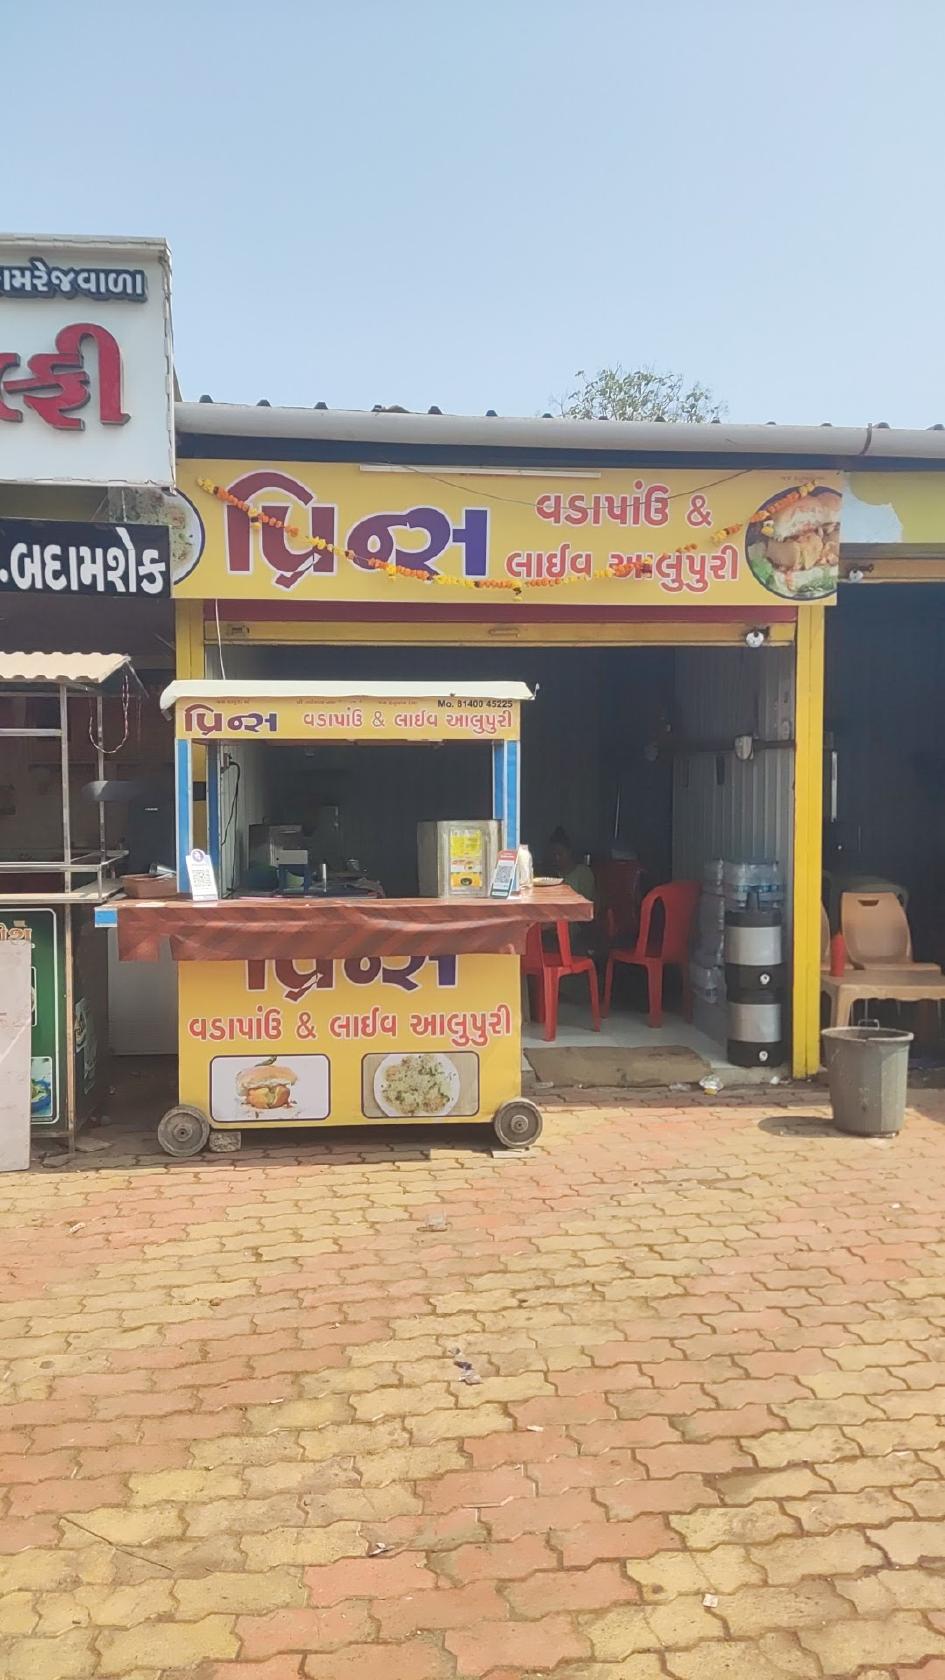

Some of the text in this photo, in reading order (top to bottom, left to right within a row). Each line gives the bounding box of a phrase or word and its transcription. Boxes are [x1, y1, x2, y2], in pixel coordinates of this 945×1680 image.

[0, 260, 145, 295] ામરેજવાળા
[536, 480, 712, 527] વડાપાંઉ &
[226, 470, 489, 590] પ્રિન્સ
[506, 544, 592, 579] લાઈવ
[184, 703, 278, 736] પ્રિન્સ
[303, 707, 363, 729] વડાપાંઉ
[372, 711, 385, 728] &
[394, 710, 439, 728] લાઈવ
[446, 710, 513, 734] આલુપુરી
[485, 699, 513, 709] 45225
[188, 1004, 512, 1046] વડાપાંઉ & લાઈવ આલુપુરી
